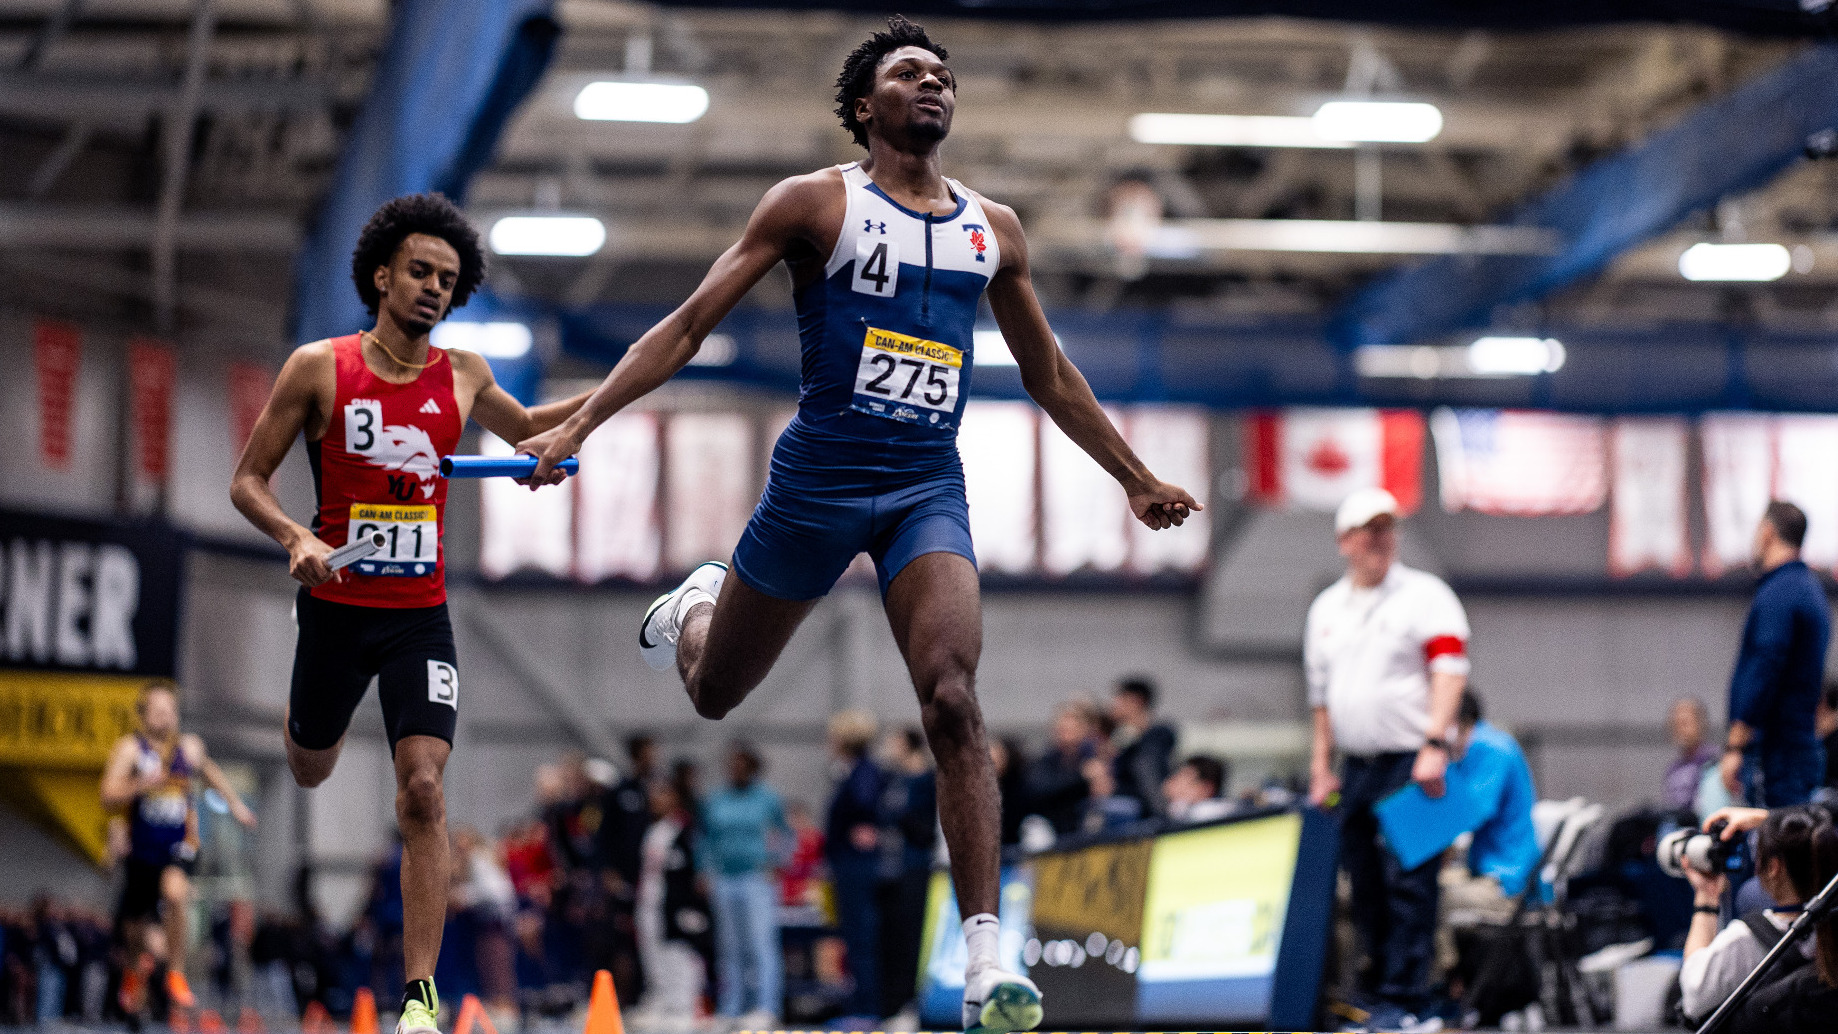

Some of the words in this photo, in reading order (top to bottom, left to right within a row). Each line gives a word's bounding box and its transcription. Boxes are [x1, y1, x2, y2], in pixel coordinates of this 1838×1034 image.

[860, 242, 889, 293] 4
[875, 335, 914, 353] CAN-AM
[865, 353, 949, 406] 275
[353, 408, 375, 451] 3
[387, 474, 417, 501] YU
[0, 538, 141, 669] NER
[437, 664, 454, 701] 3
